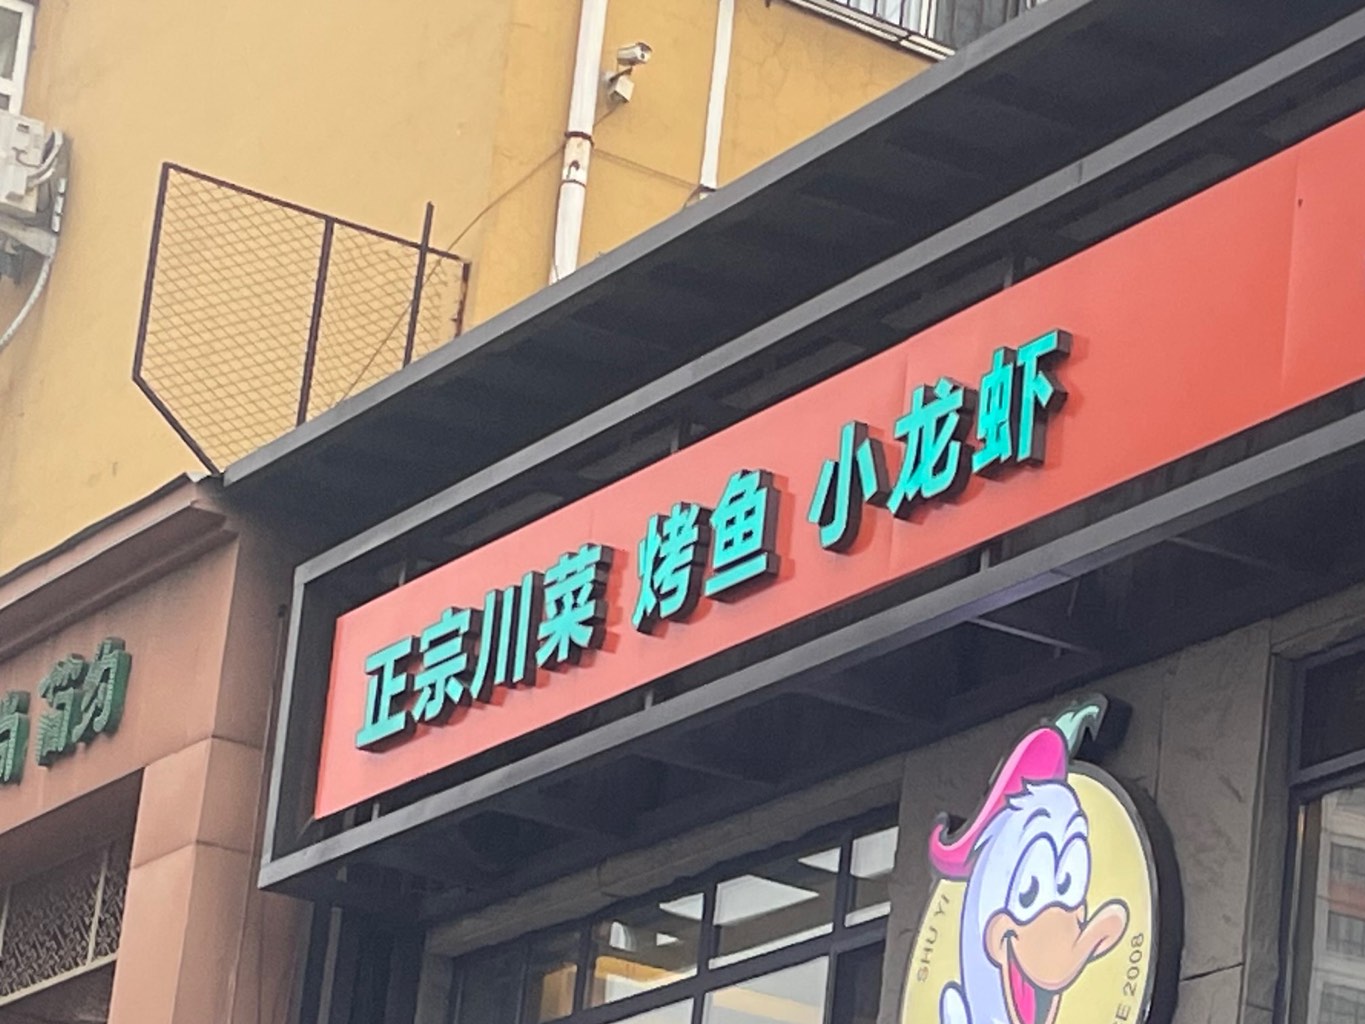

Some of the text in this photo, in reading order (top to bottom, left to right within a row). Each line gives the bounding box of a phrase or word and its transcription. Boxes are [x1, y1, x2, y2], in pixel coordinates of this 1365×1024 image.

[356, 330, 1060, 750] 正宗川菜 烤鱼 小龙虾
[1122, 932, 1145, 997] 2008
